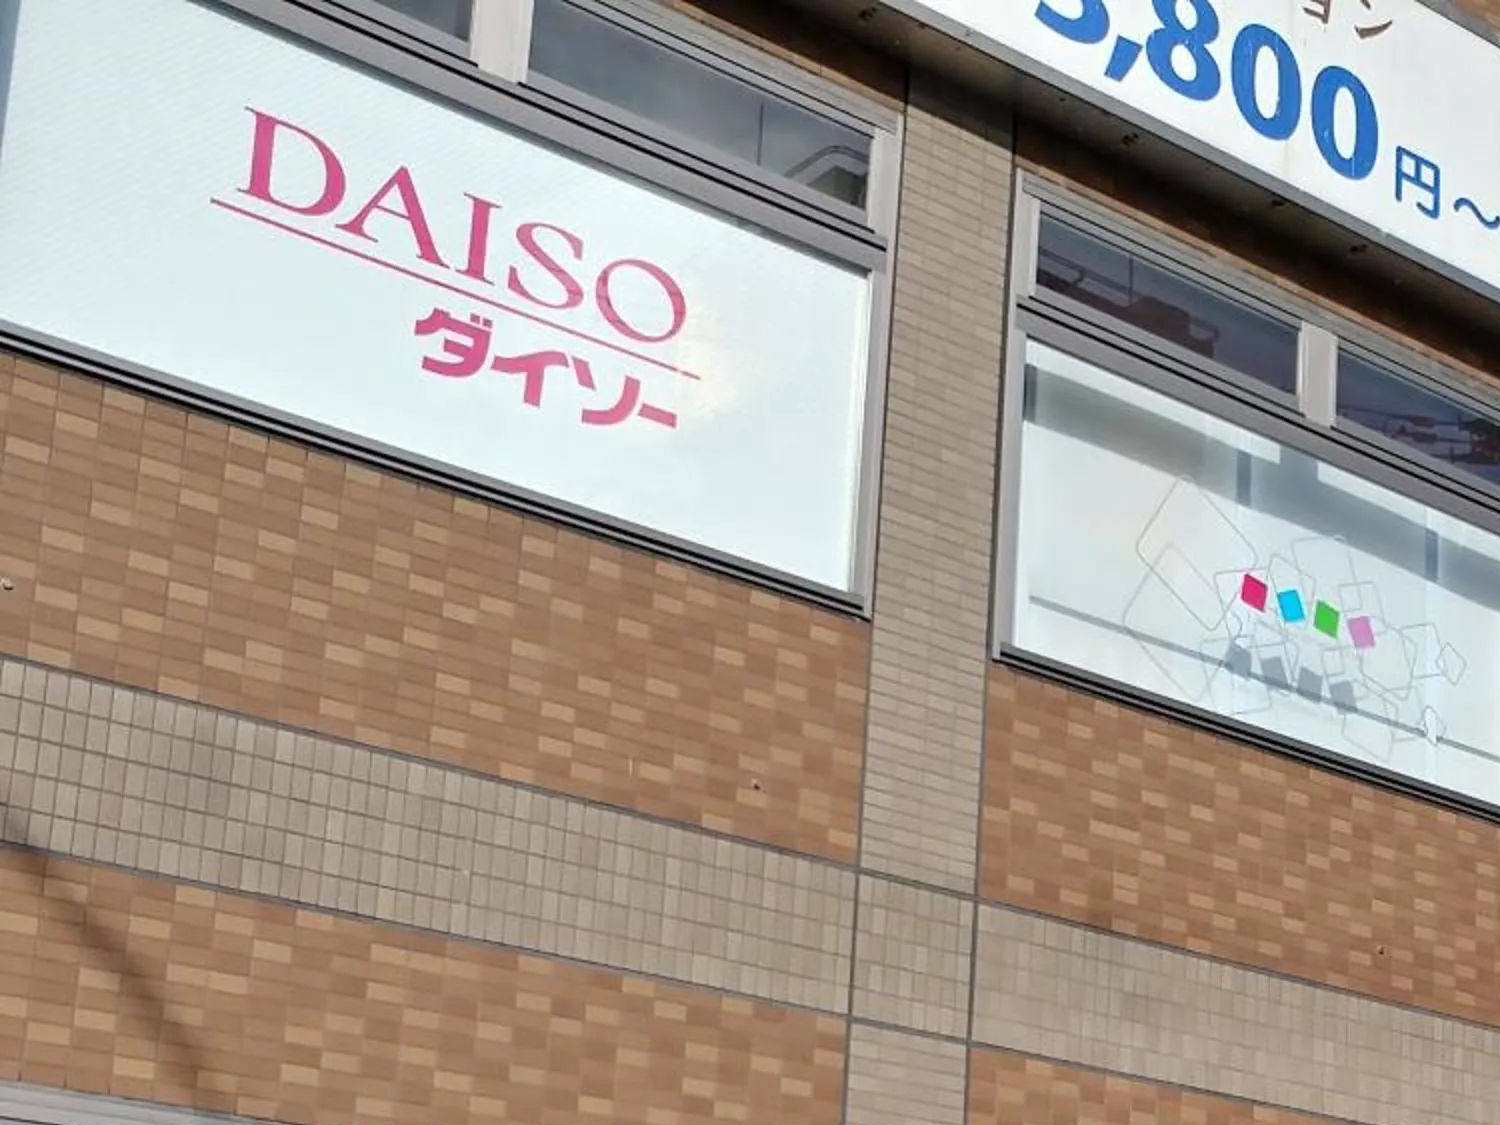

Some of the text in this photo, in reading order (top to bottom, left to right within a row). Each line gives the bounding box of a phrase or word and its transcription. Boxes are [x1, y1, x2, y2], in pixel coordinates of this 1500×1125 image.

[236, 107, 687, 344] DAISO
[415, 307, 678, 429] ダイソー
